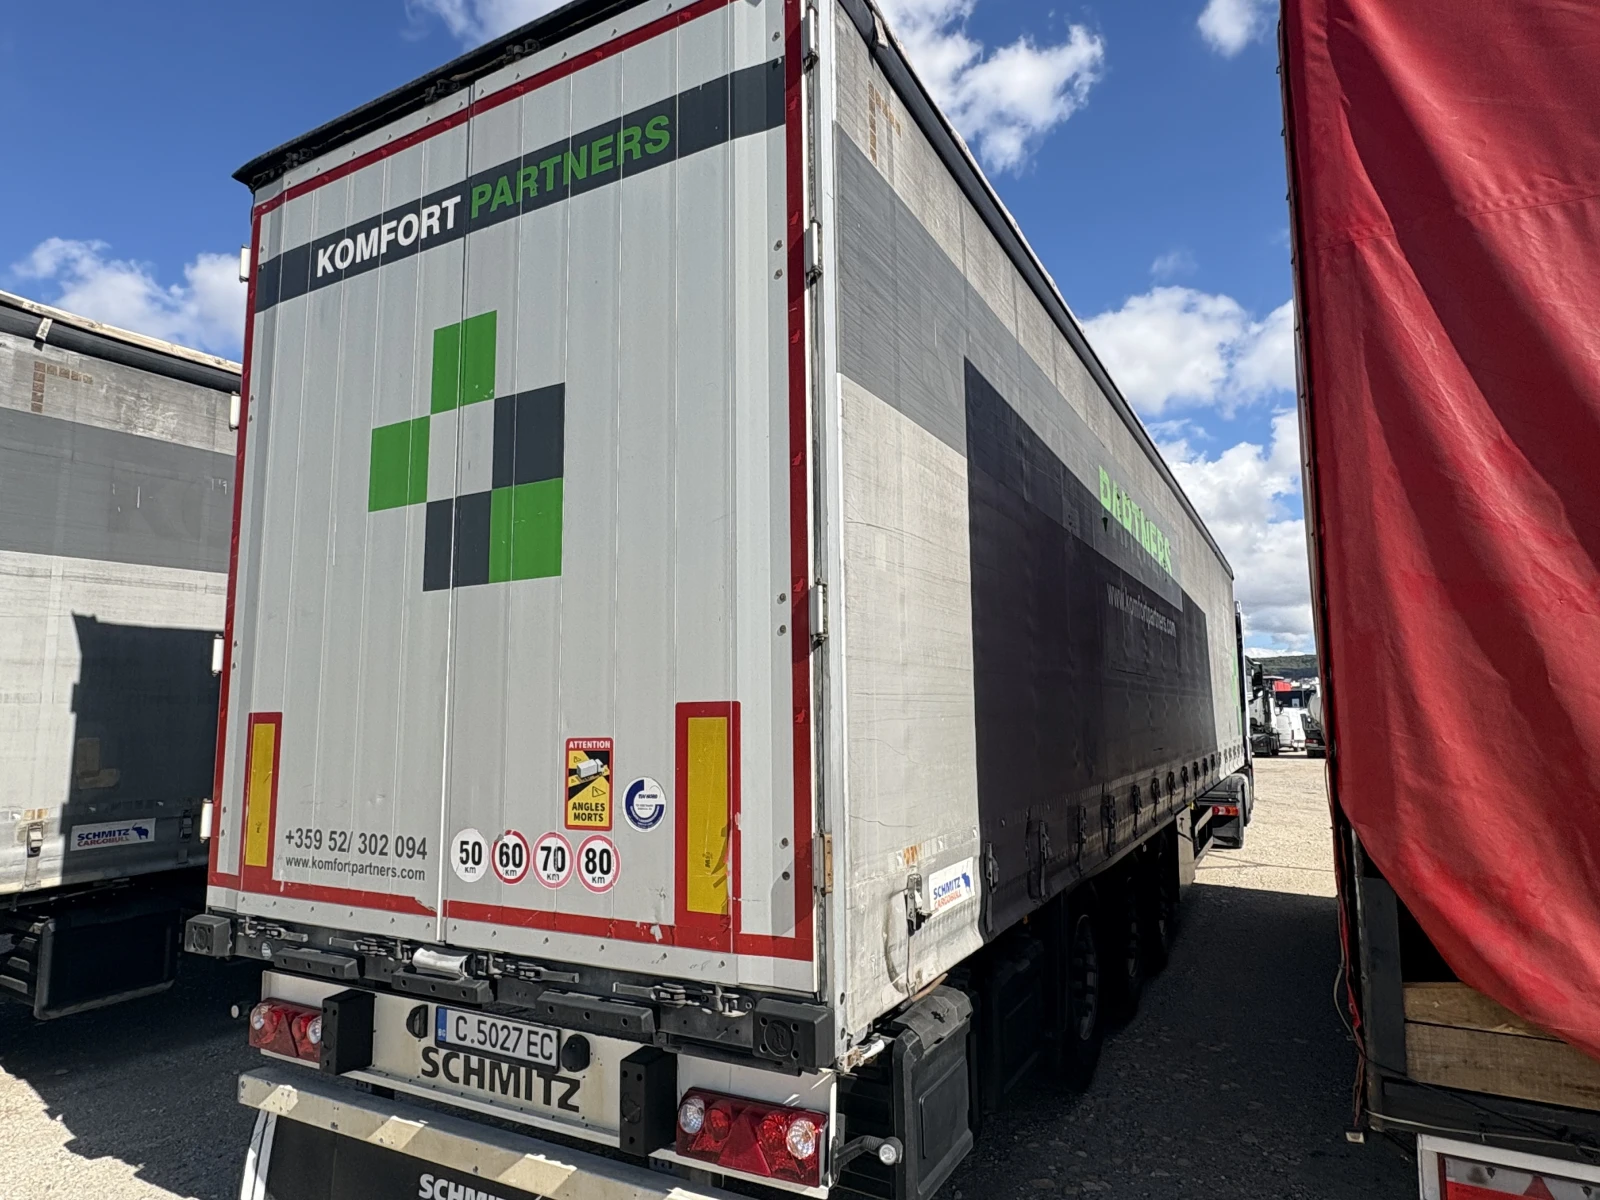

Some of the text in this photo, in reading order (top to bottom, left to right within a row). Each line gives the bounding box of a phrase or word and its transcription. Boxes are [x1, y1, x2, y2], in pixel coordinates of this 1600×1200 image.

[316, 115, 671, 278] KOMFORT PARTNERS
[568, 740, 611, 749] ATTENTION
[571, 801, 606, 812] ANGLES
[573, 812, 604, 822] MORTS
[77, 828, 130, 841] SCHMITZ
[285, 827, 323, 850] +359
[328, 830, 354, 853] 52/
[358, 832, 389, 857] 302
[395, 835, 428, 861] 094
[459, 840, 483, 866] 50
[499, 842, 524, 868] 60
[540, 845, 566, 873] 70
[584, 847, 612, 875] 80
[285, 856, 426, 881] www.komfortpartners.com
[933, 876, 961, 900] SCHMITZ
[437, 1028, 447, 1038] BG
[421, 1046, 581, 1113] SCHMITZ
